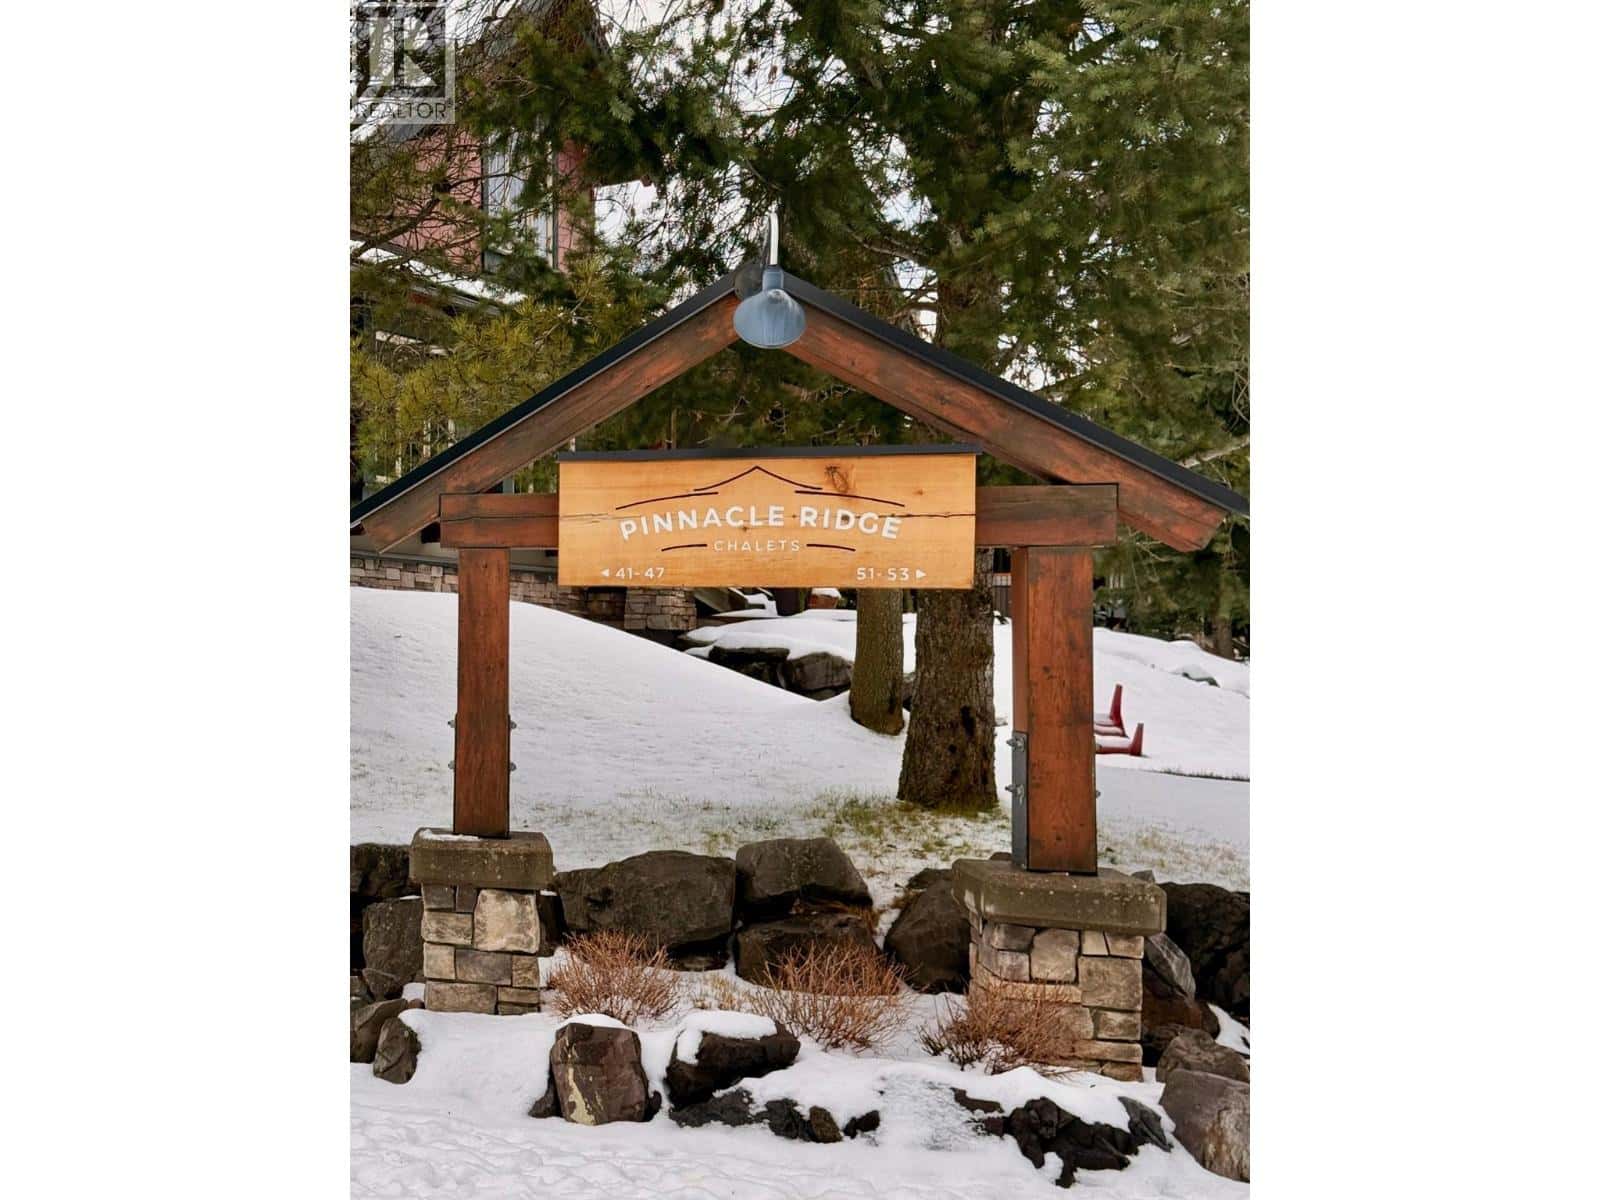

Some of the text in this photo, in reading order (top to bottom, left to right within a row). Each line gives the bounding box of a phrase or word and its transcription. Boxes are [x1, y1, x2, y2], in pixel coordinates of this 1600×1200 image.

[620, 505, 902, 540] PINNACLE RIDGE
[714, 540, 800, 552] CHALETS
